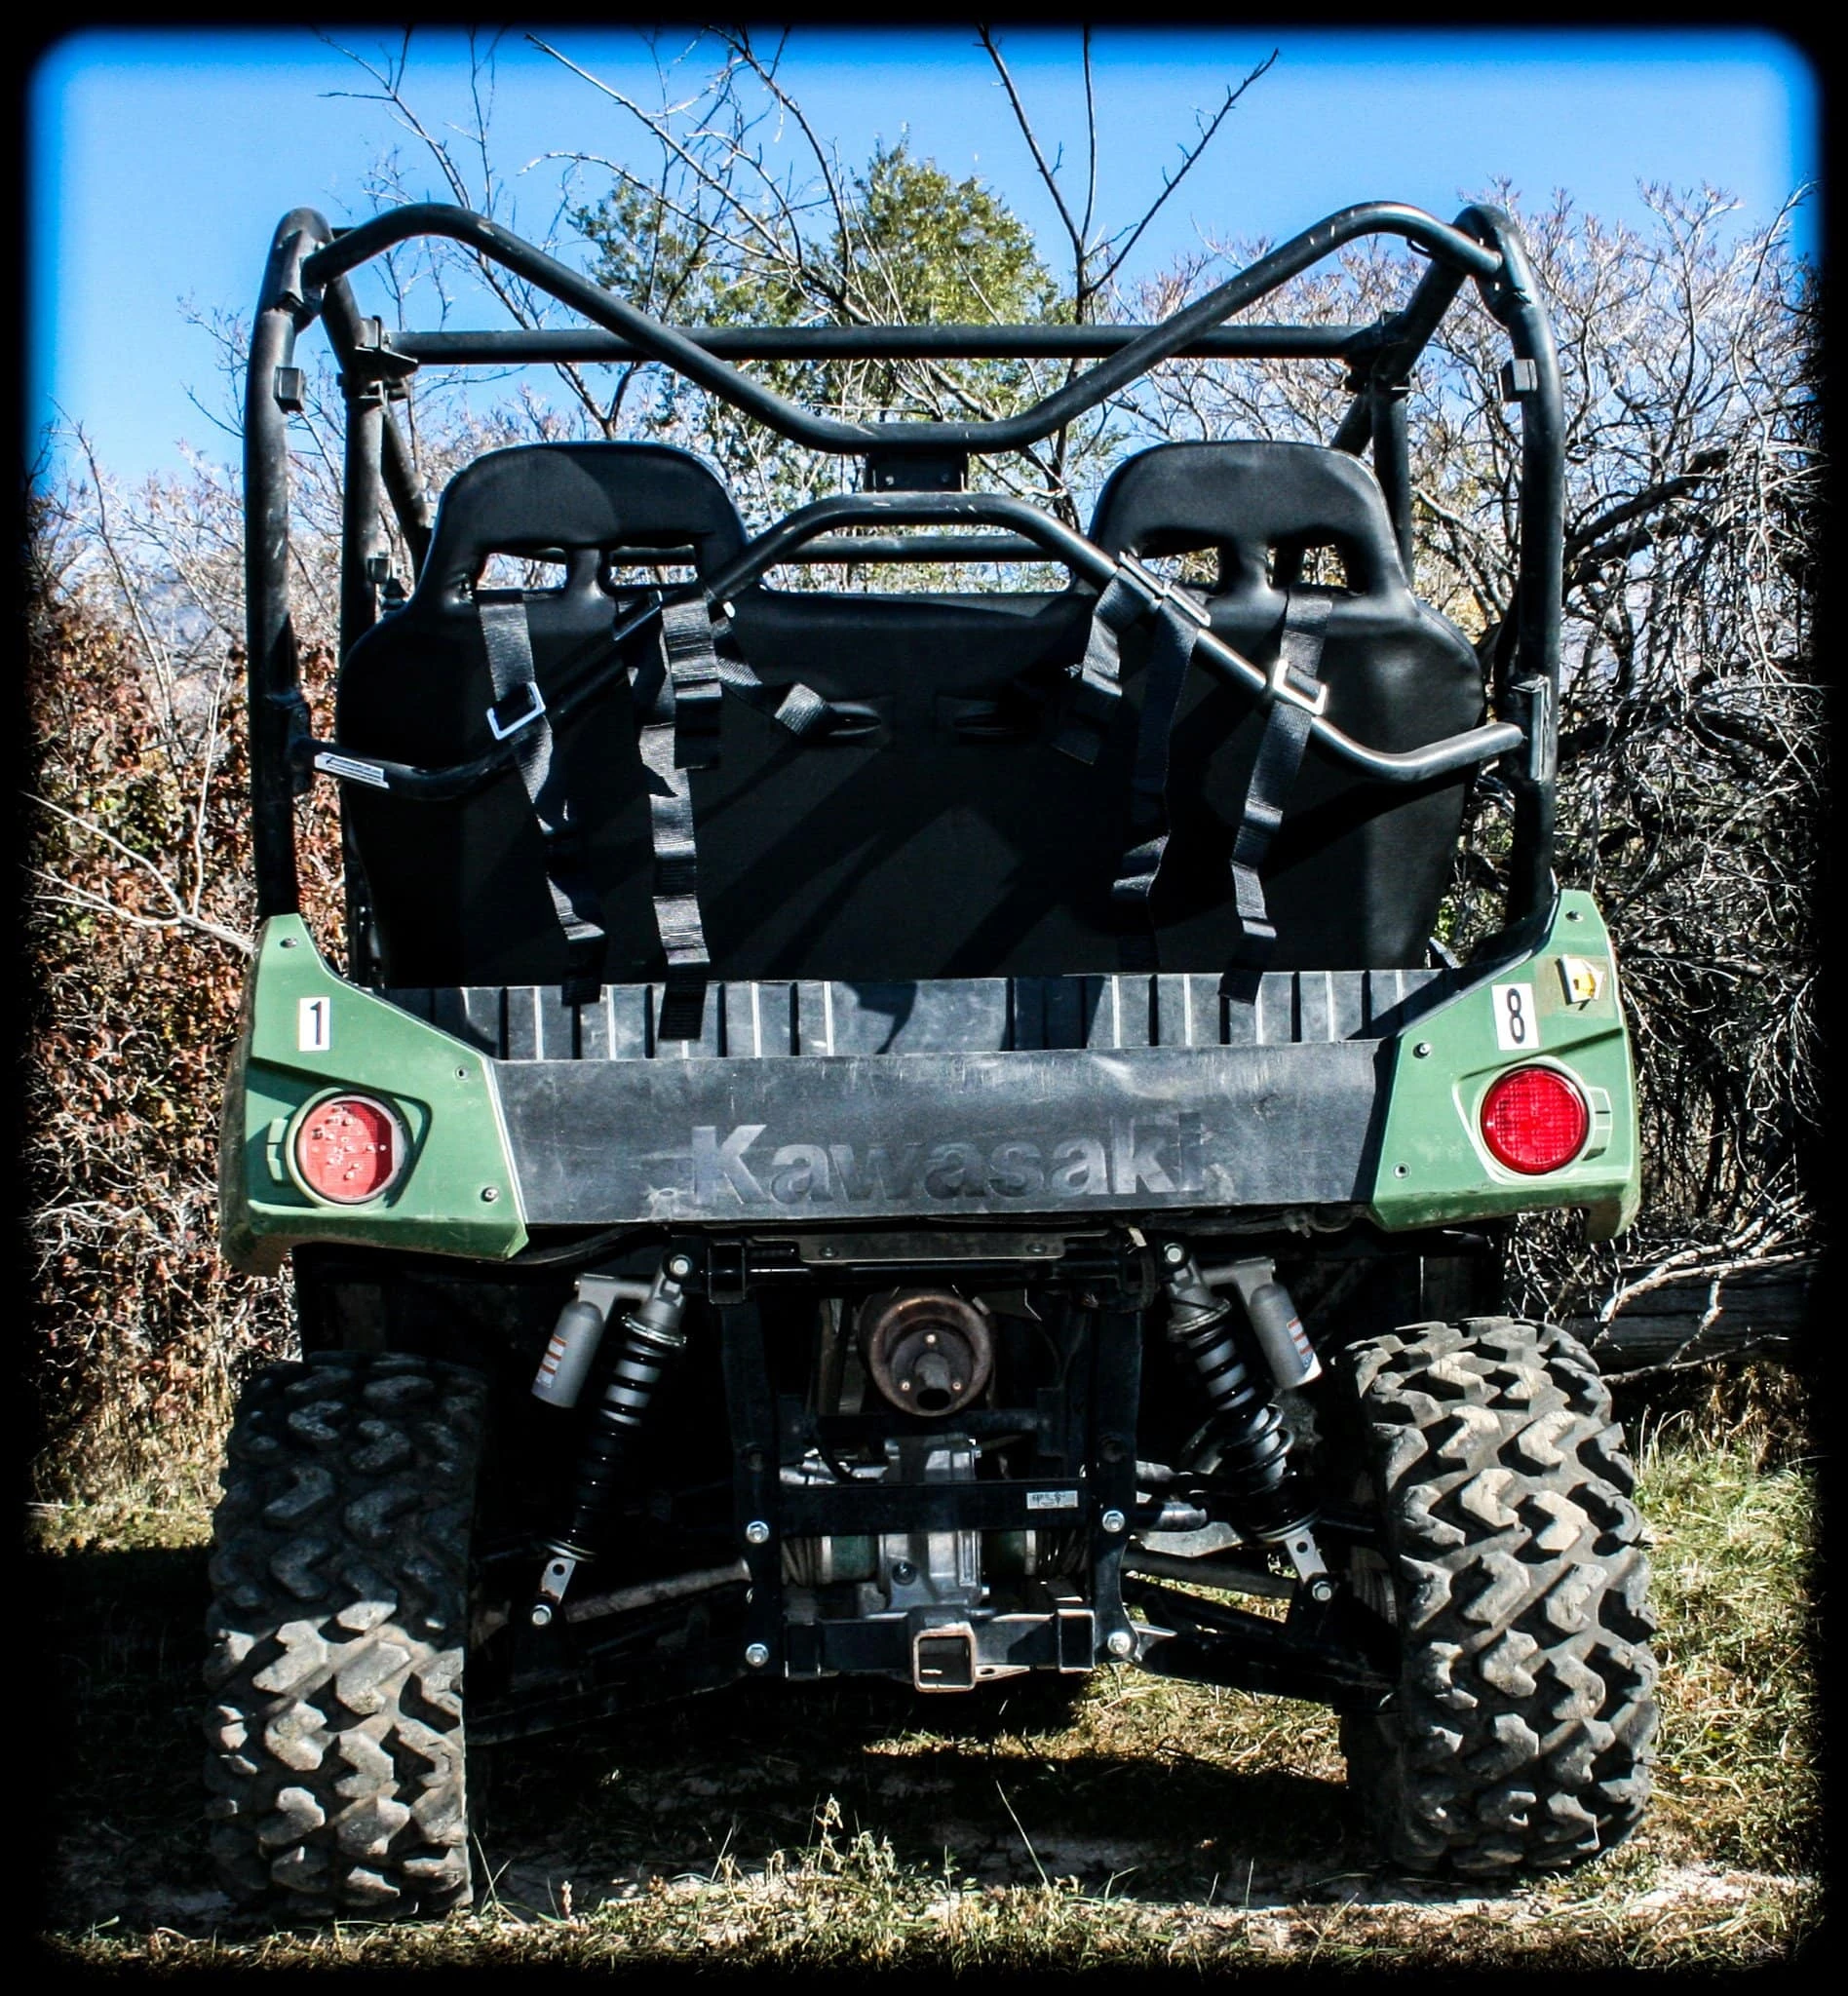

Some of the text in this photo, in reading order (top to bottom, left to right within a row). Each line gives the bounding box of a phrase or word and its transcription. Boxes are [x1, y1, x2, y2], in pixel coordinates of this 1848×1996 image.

[309, 1000, 323, 1046] 1
[1506, 987, 1525, 1044] 8
[691, 1112, 1204, 1206] Kawasaki
